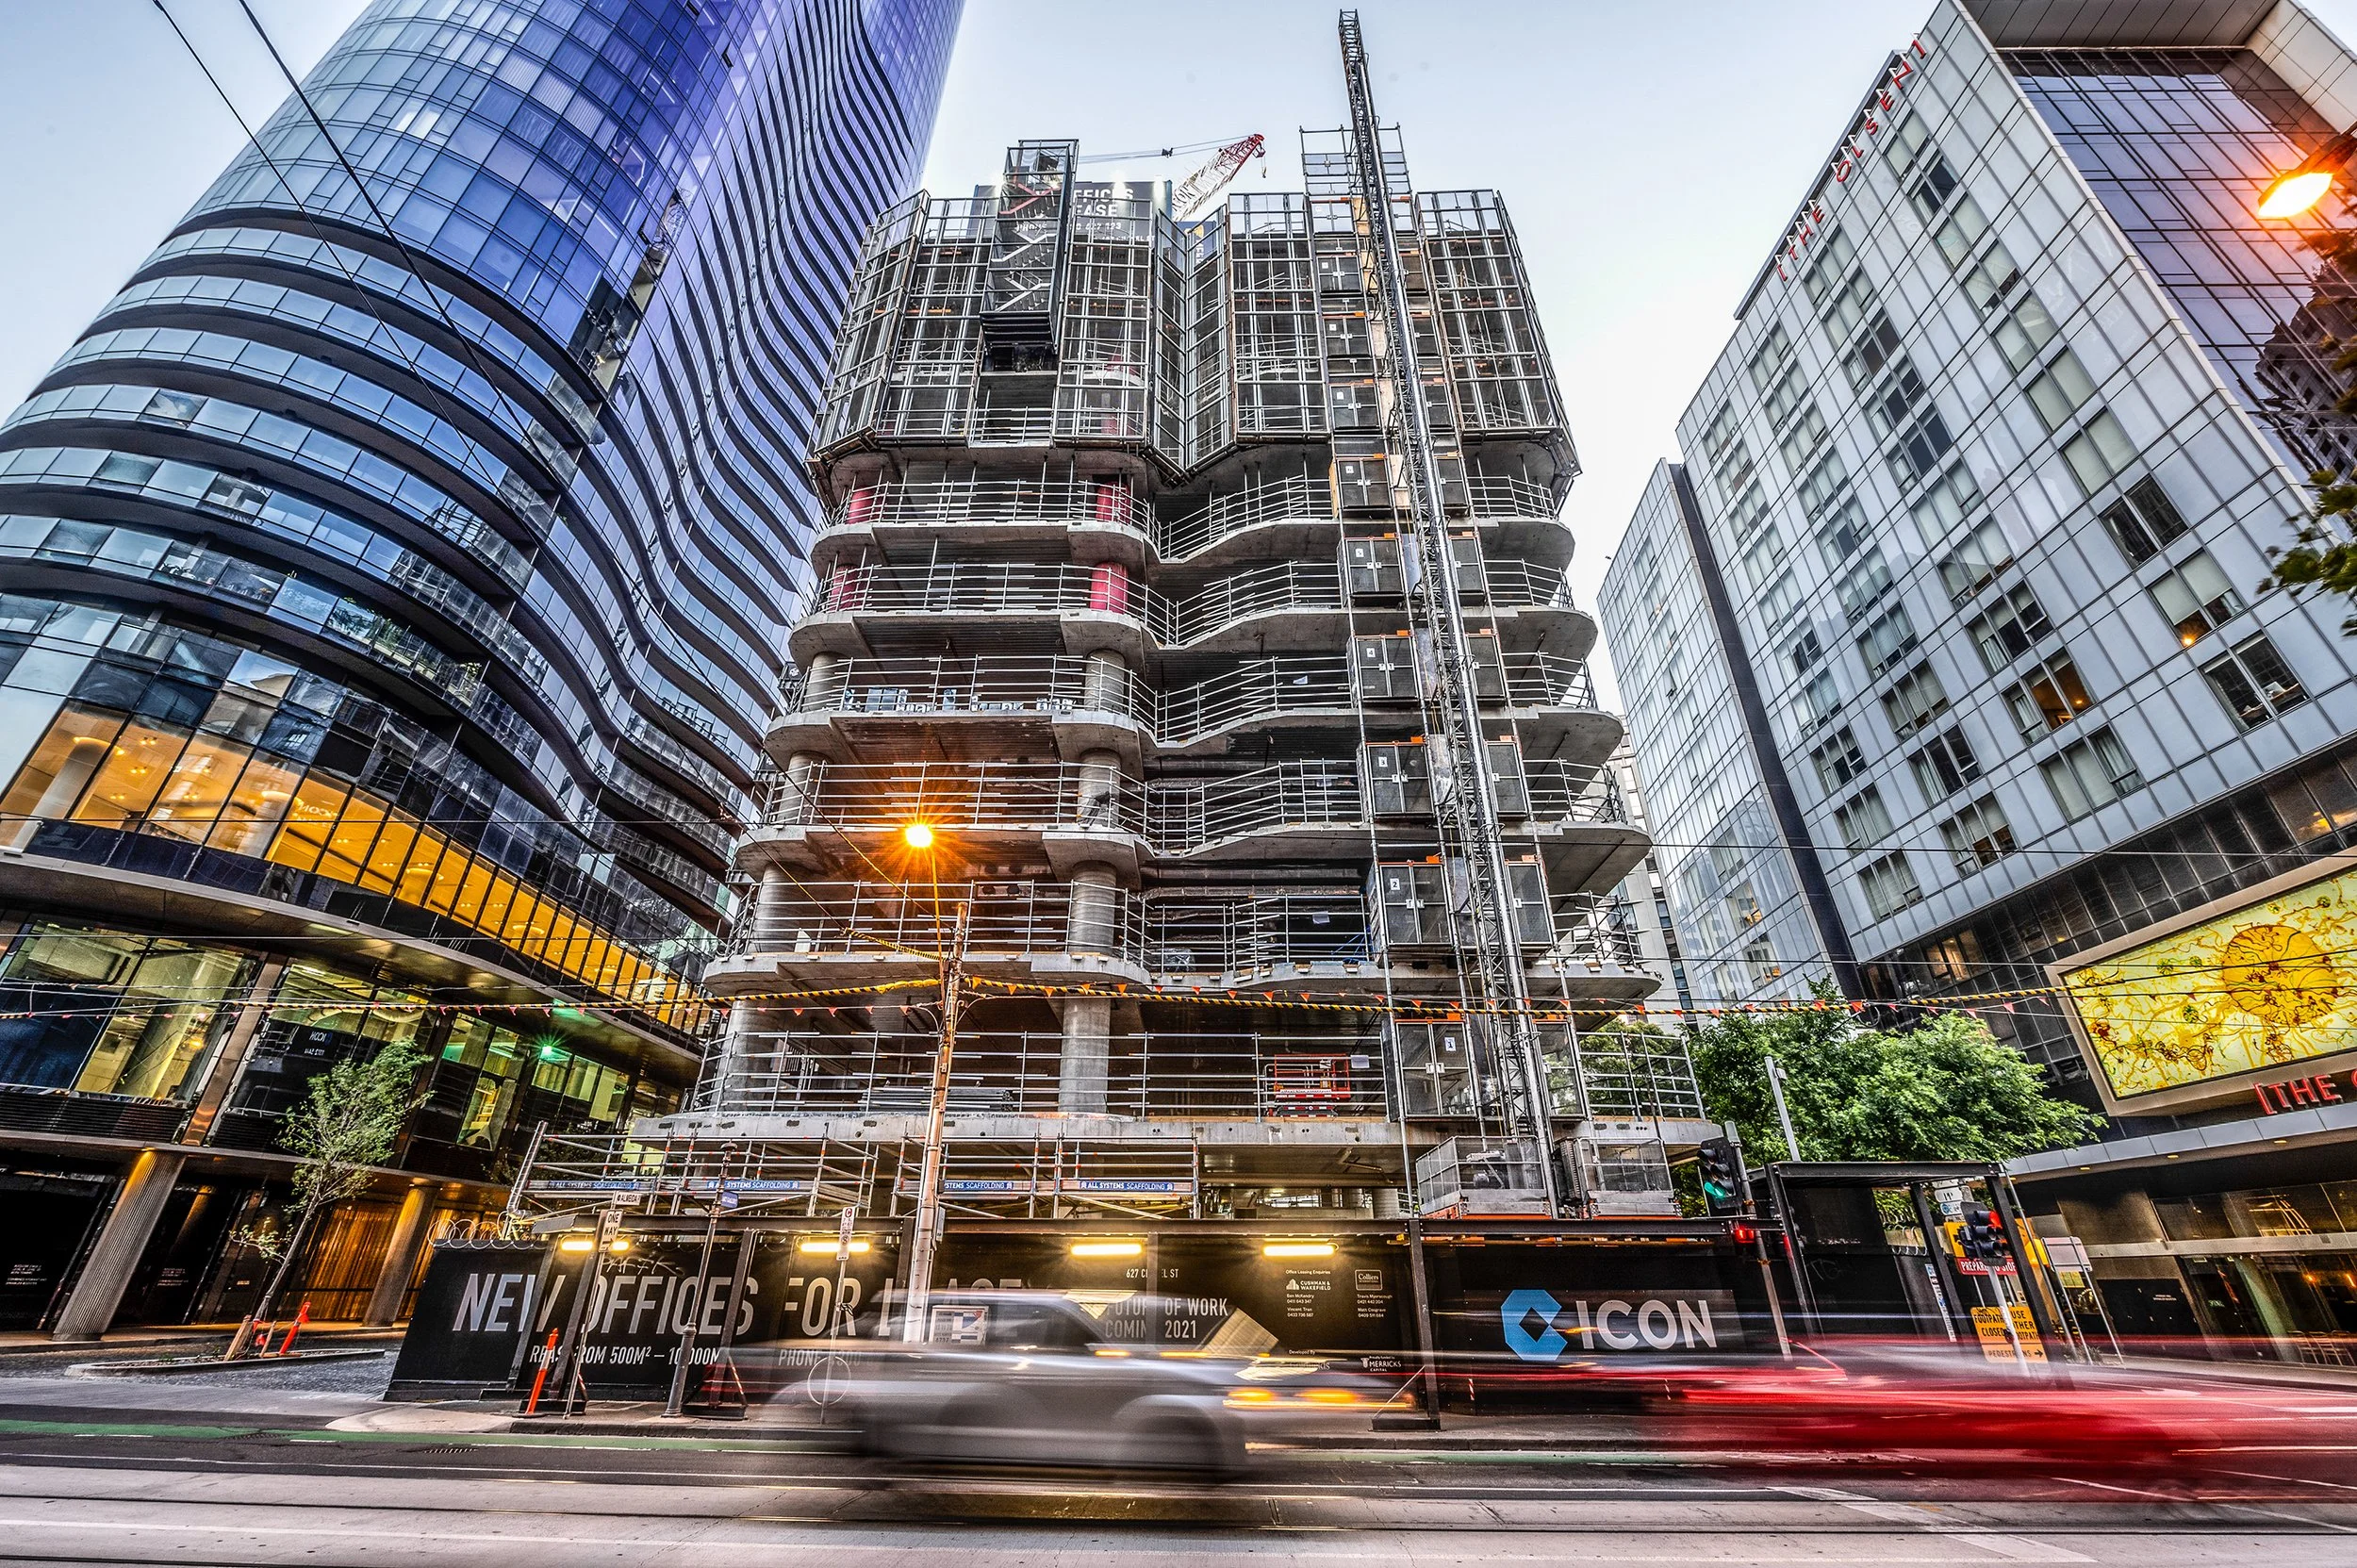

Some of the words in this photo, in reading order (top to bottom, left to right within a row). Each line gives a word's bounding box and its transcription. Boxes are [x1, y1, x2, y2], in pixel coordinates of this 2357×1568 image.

[1076, 205, 1118, 218] EASE
[607, 1213, 620, 1224] ONE
[603, 1227, 618, 1236] WAY
[1126, 1268, 1139, 1279] 627
[1170, 1268, 1178, 1279] ST
[1164, 1297, 1182, 1316] OF
[1187, 1297, 1228, 1316] WORK
[1973, 1313, 2005, 1324] FOOTPATH
[1105, 1319, 1147, 1338] COMIN
[1164, 1319, 1197, 1339] 2021
[1575, 1299, 1718, 1350] ICON
[1981, 1327, 2005, 1337] CLOSED
[574, 1345, 607, 1364] ROM
[1369, 1360, 1402, 1368] MERRICKS
